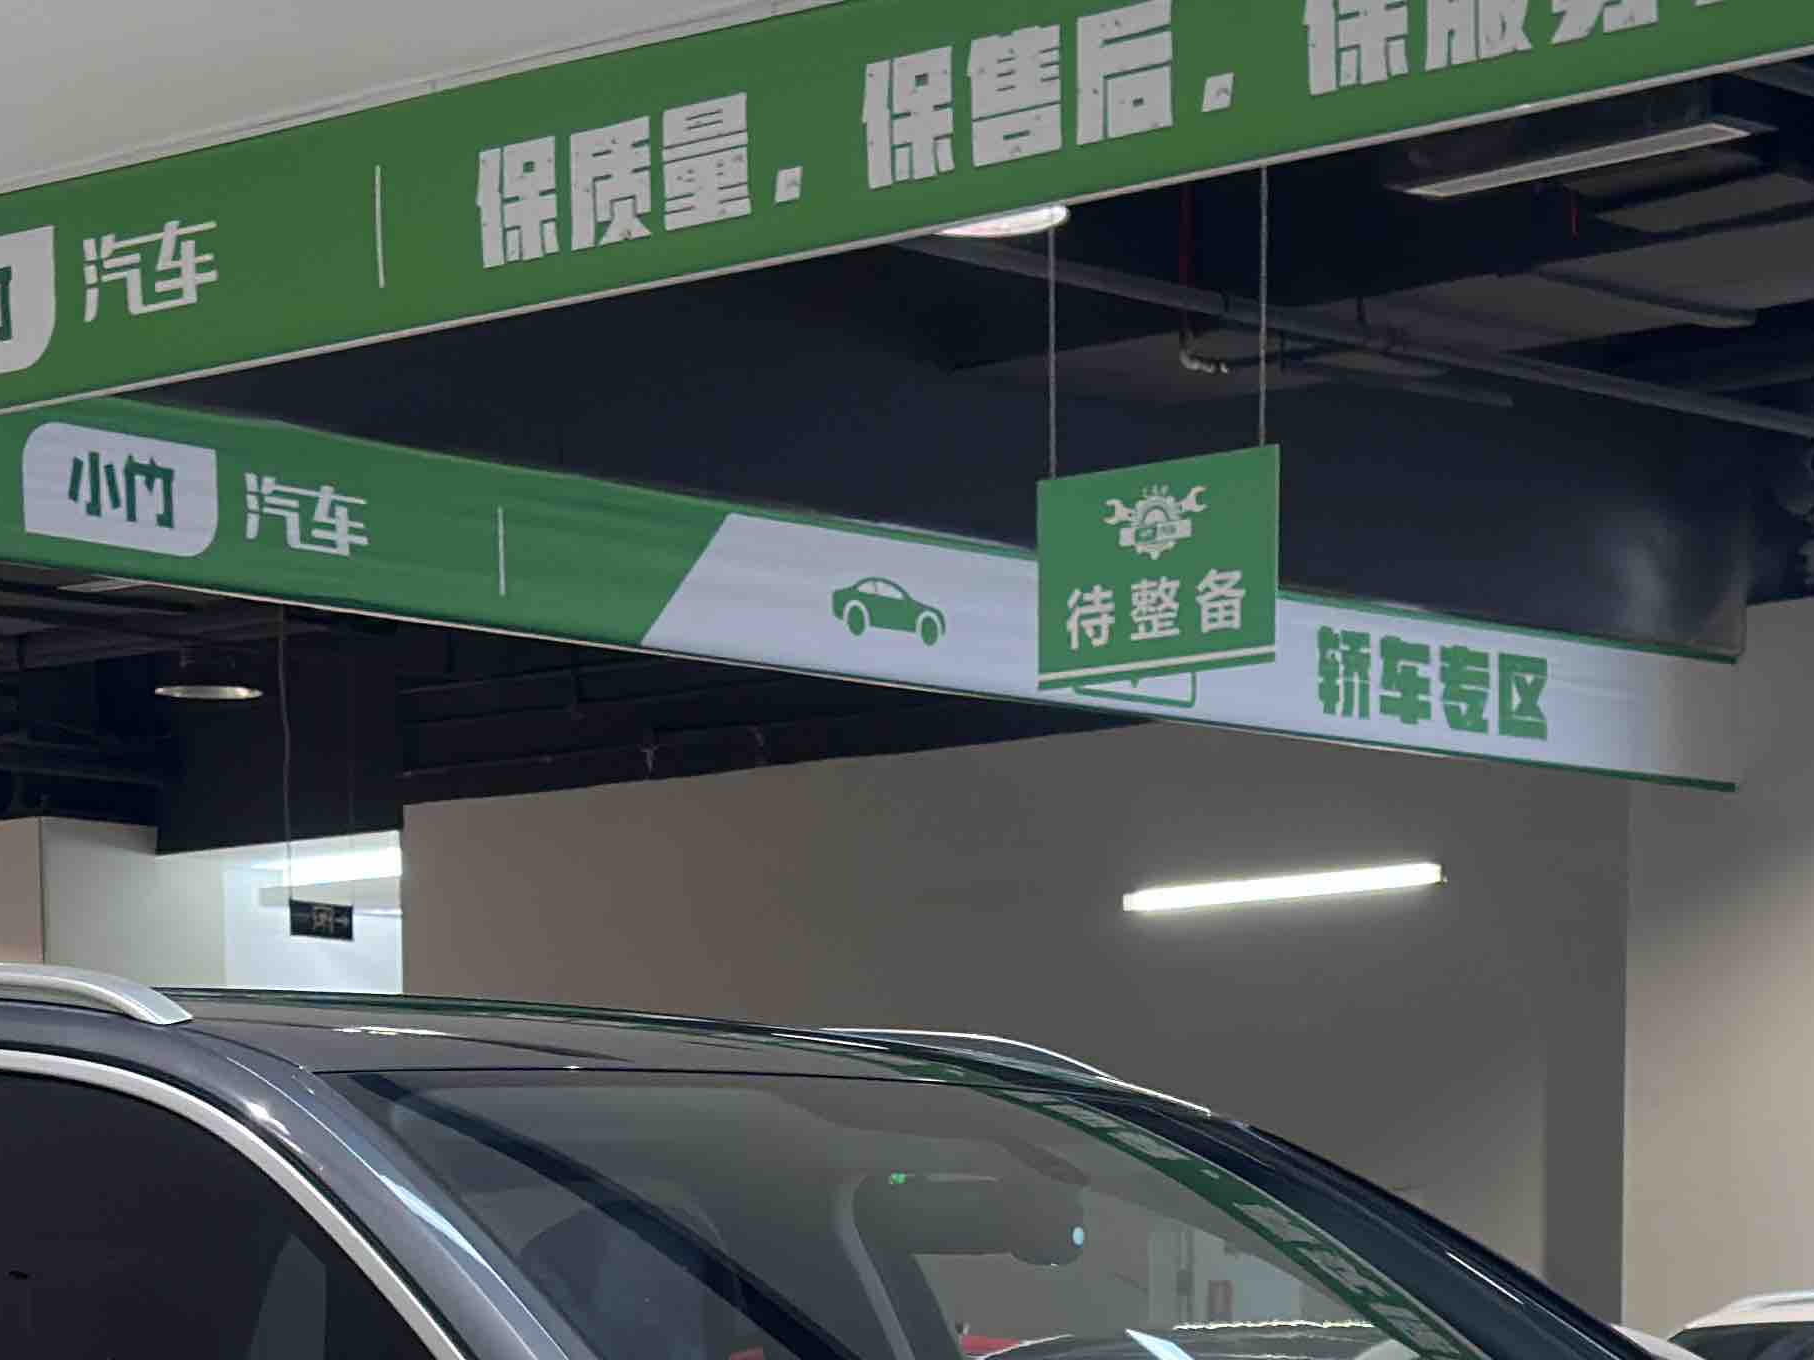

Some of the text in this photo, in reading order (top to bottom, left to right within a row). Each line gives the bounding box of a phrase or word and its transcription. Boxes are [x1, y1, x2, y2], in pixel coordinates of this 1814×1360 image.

[83, 220, 219, 323] 汽车
[68, 450, 370, 557] 小竹 汽车
[1067, 569, 1246, 651] 待整备
[1318, 625, 1548, 740] 轿车专区
